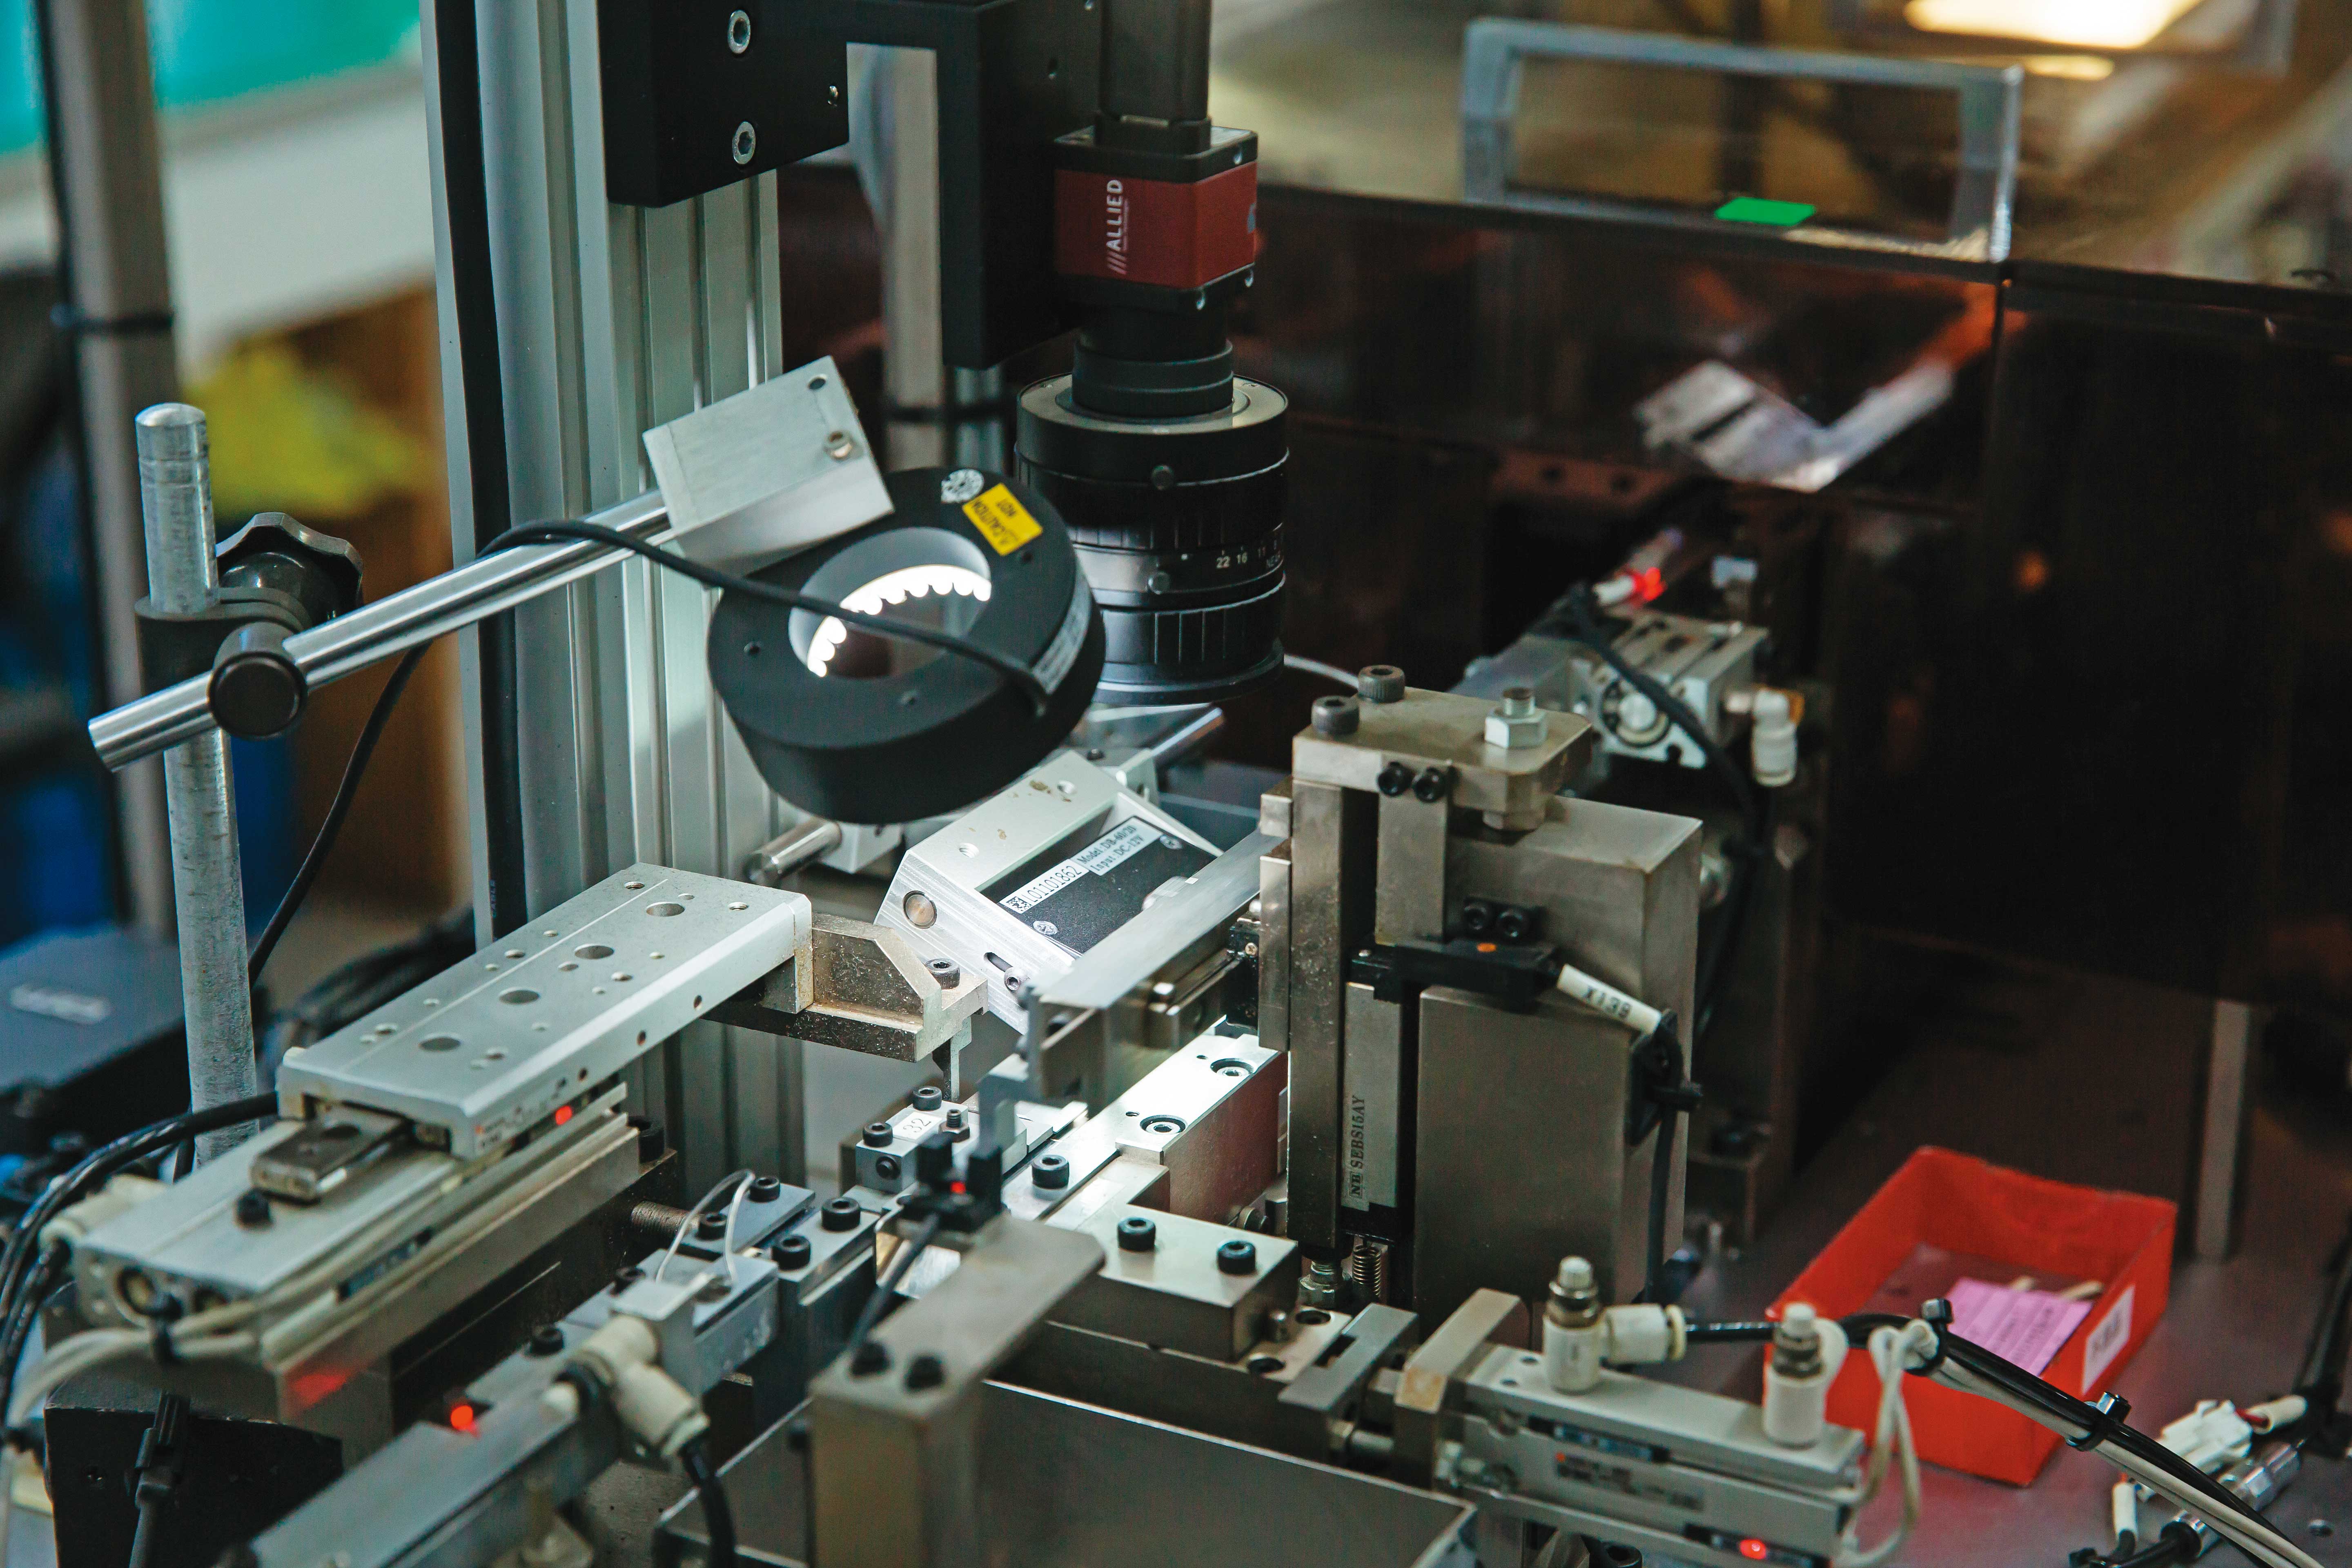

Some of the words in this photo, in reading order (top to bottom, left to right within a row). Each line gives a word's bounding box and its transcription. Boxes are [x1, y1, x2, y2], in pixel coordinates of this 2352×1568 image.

[1106, 179, 1123, 252] ALLIED
[1216, 556, 1230, 569] 22
[1236, 552, 1248, 564] 16
[1021, 866, 1082, 902] L01101862
[903, 1118, 931, 1133] 32
[1350, 1094, 1365, 1169] SEBS15AY
